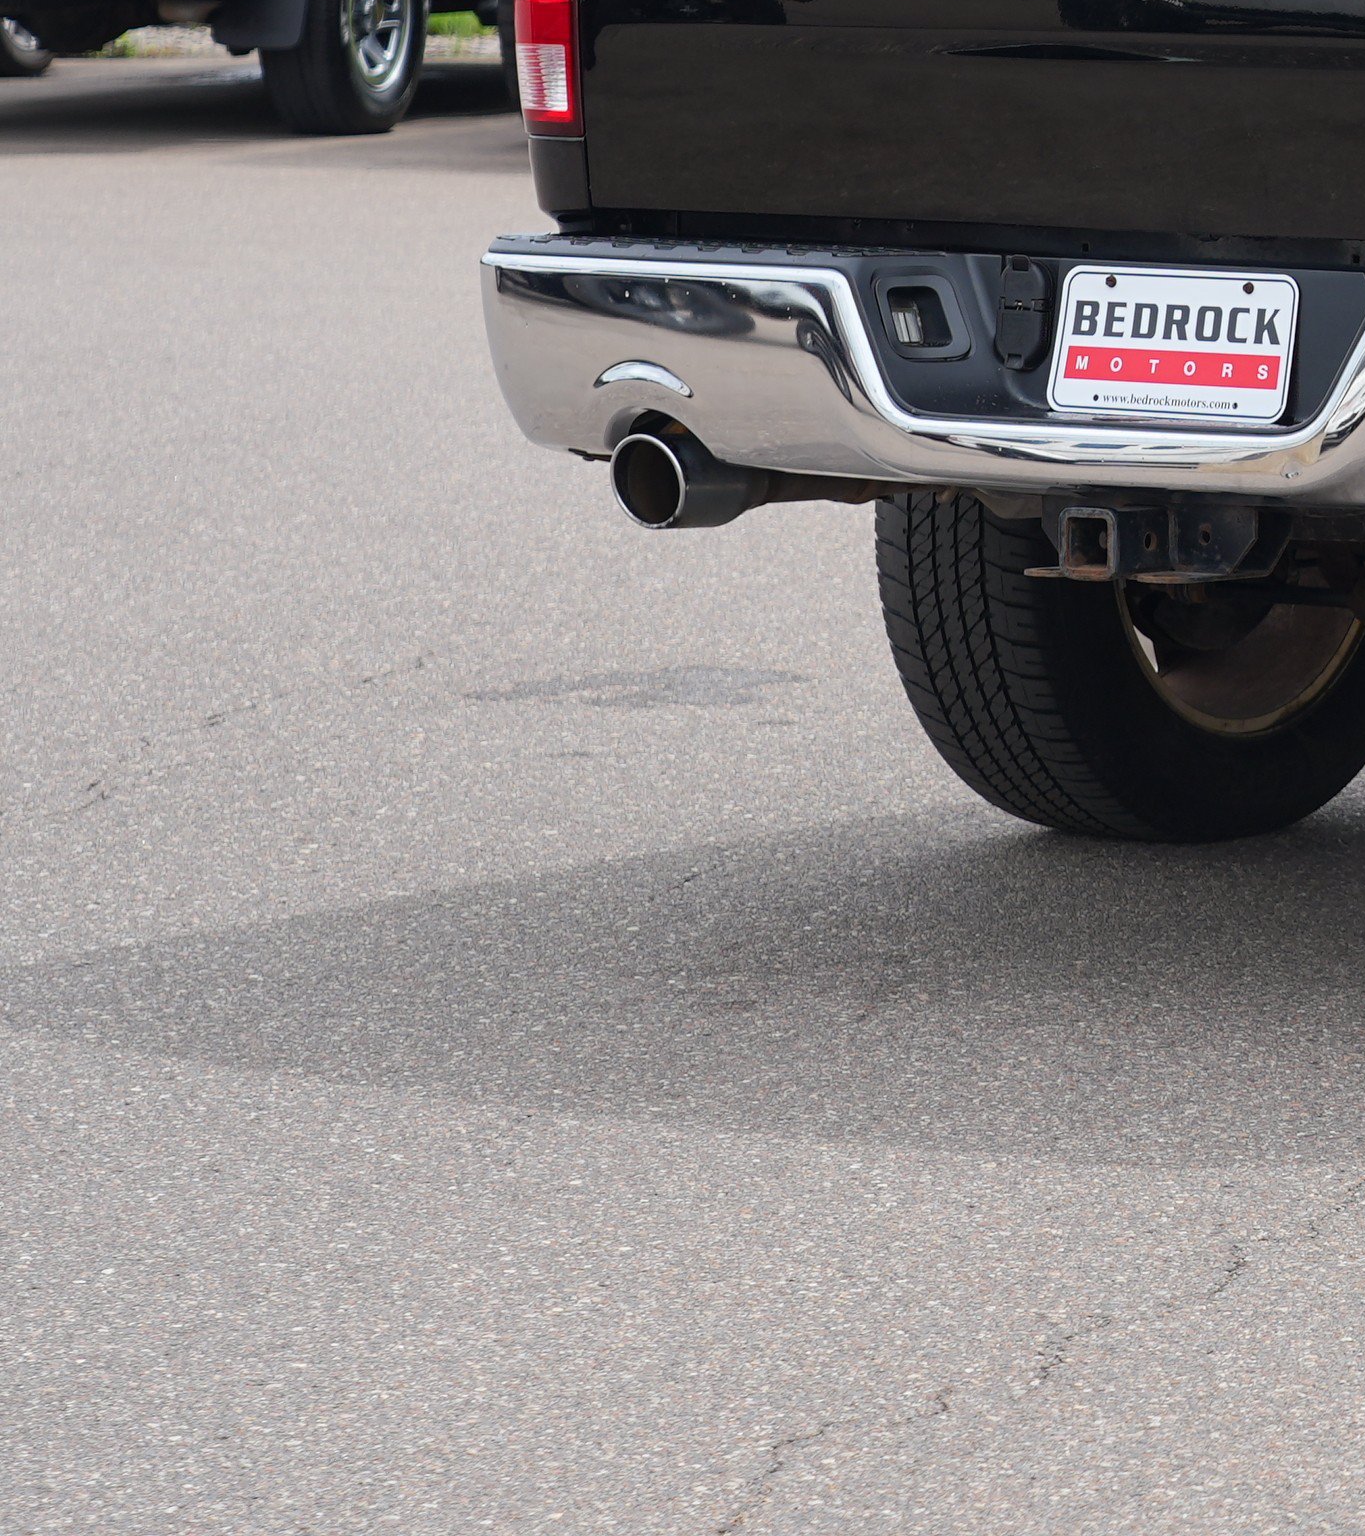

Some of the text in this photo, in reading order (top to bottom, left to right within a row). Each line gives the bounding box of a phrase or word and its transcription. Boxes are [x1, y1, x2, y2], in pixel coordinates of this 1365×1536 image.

[1071, 300, 1281, 345] BEDROCK
[1075, 354, 1269, 380] MOTORS
[1102, 393, 1231, 411] www.bedrockmotors.com
